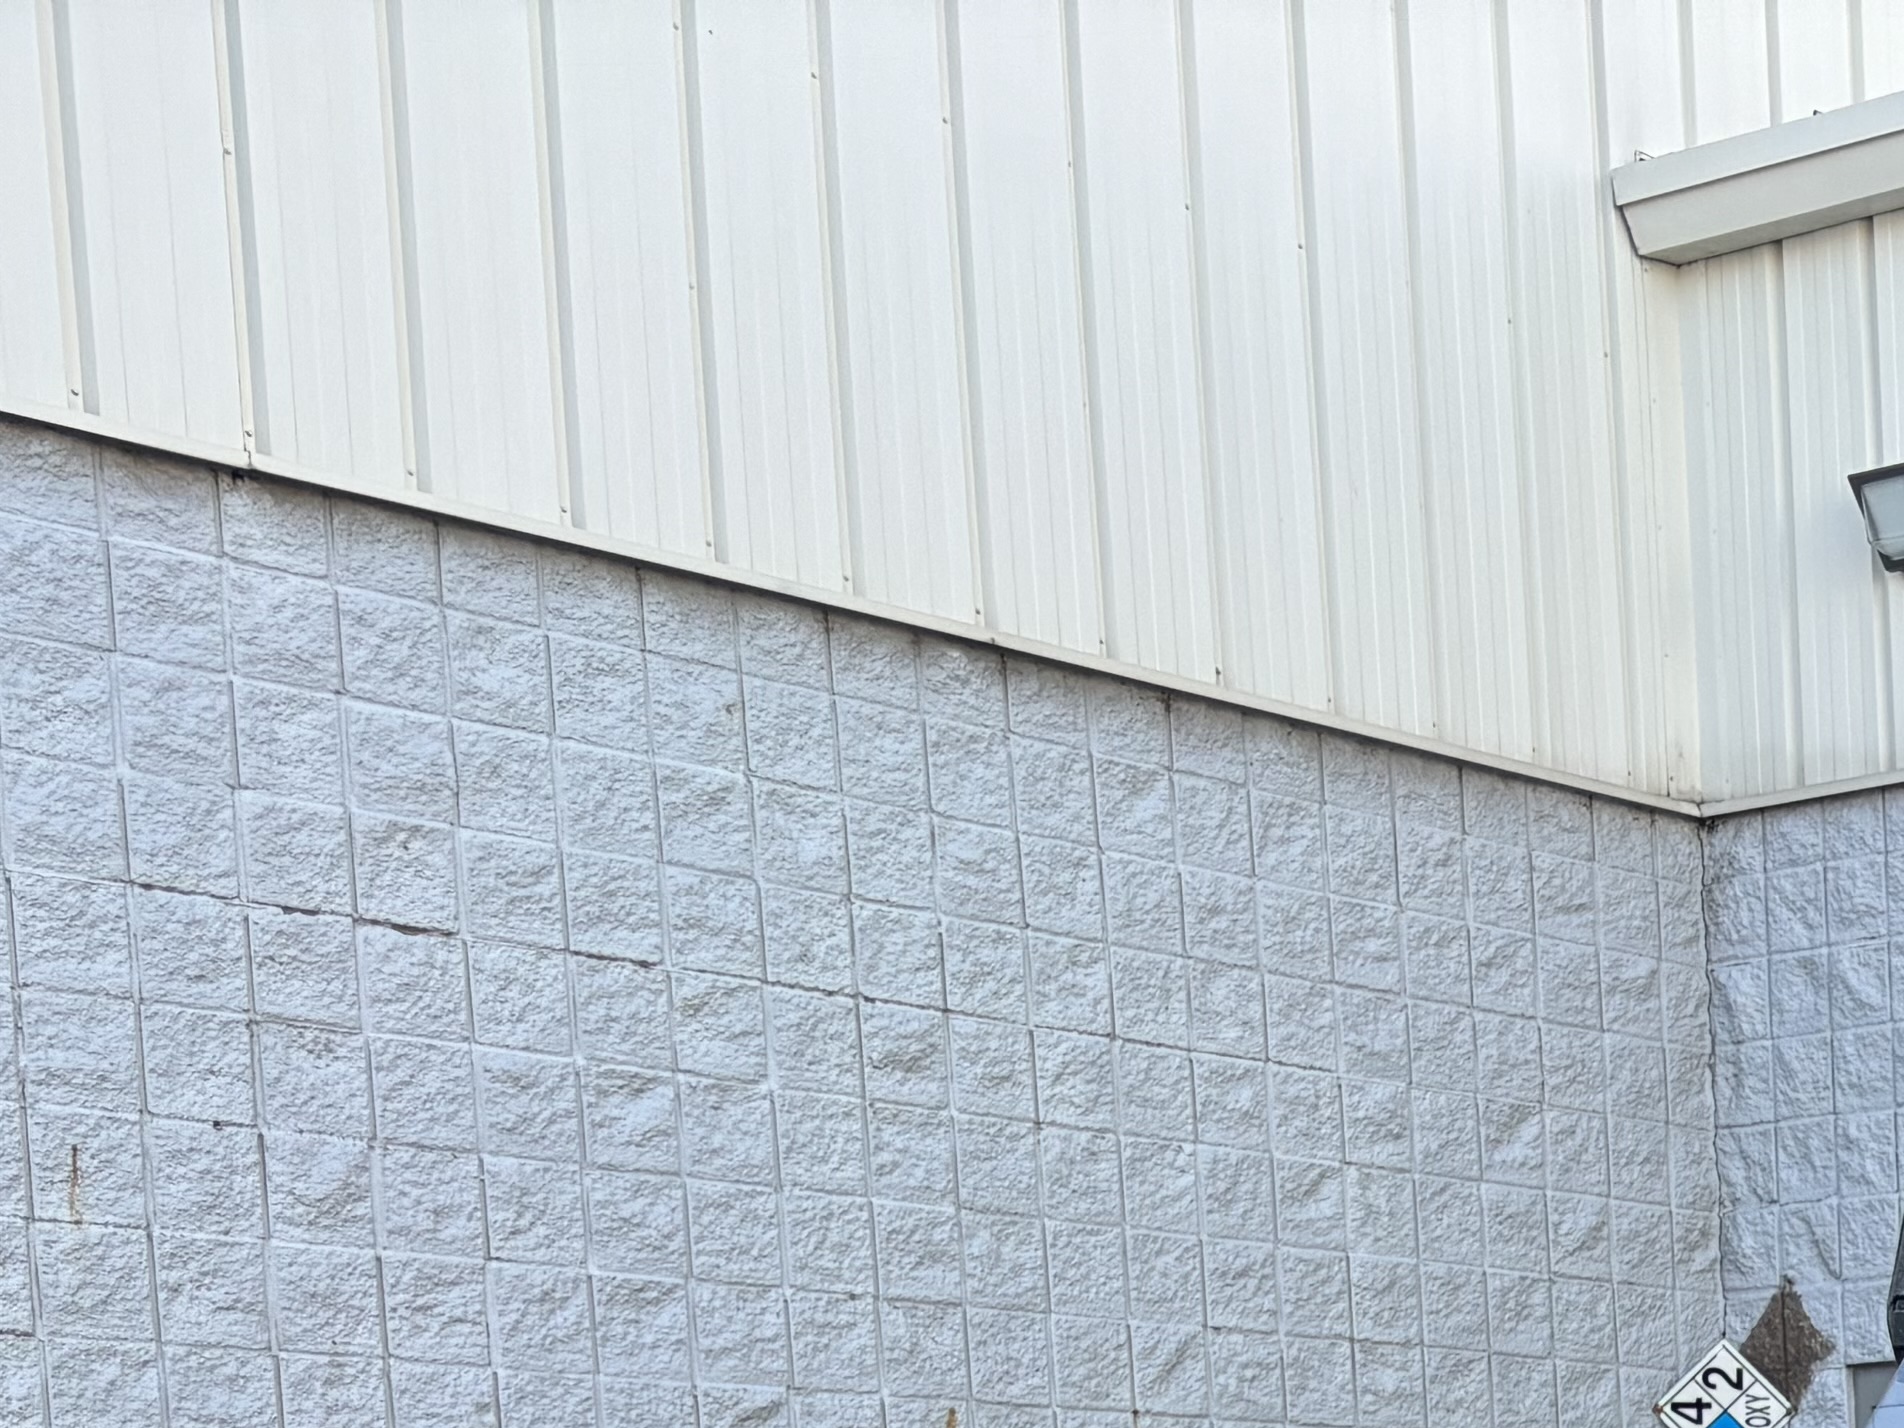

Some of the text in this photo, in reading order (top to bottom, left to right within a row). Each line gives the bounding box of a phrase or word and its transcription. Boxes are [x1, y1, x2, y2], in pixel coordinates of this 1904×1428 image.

[1702, 1368, 1743, 1390] 2
[1671, 1398, 1712, 1425] 4
[1745, 1394, 1771, 1428] OXY
